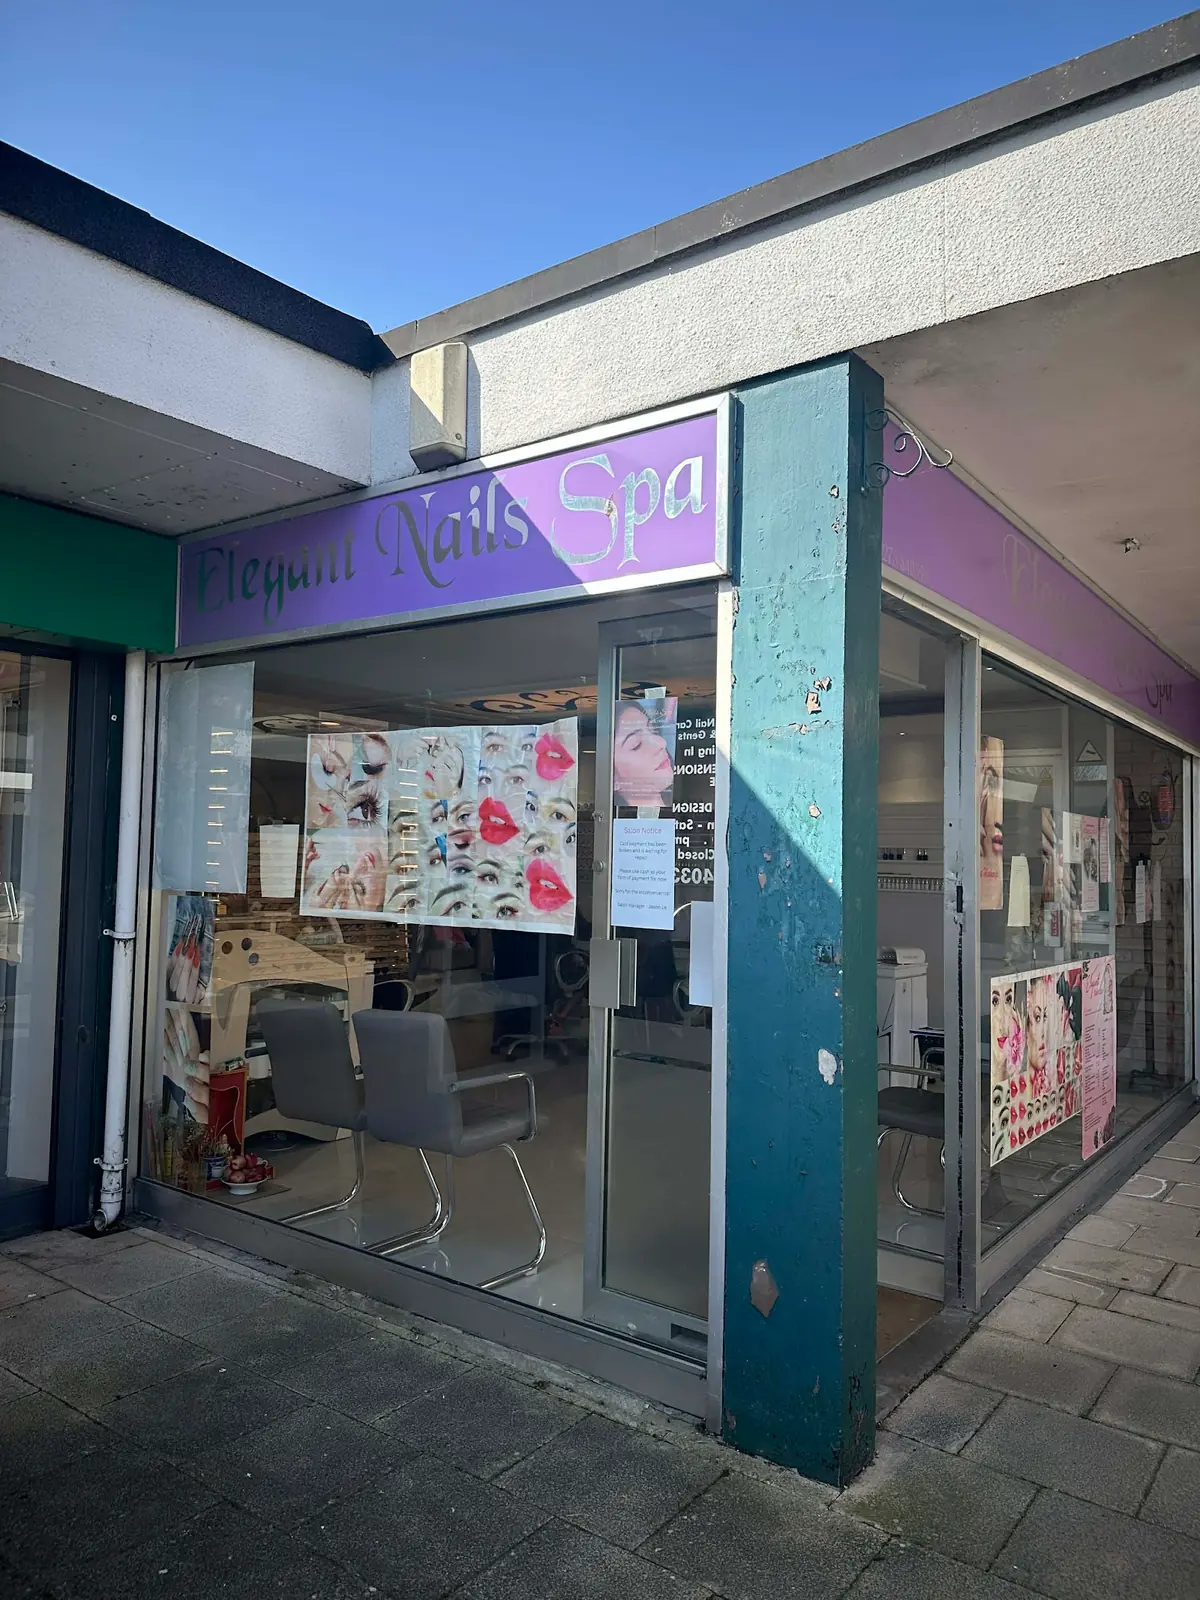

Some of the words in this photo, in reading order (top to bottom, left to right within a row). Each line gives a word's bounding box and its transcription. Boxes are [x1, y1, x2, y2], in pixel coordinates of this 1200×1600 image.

[193, 529, 357, 627] Elegant
[375, 473, 529, 589] Nails
[550, 453, 709, 570] Spa
